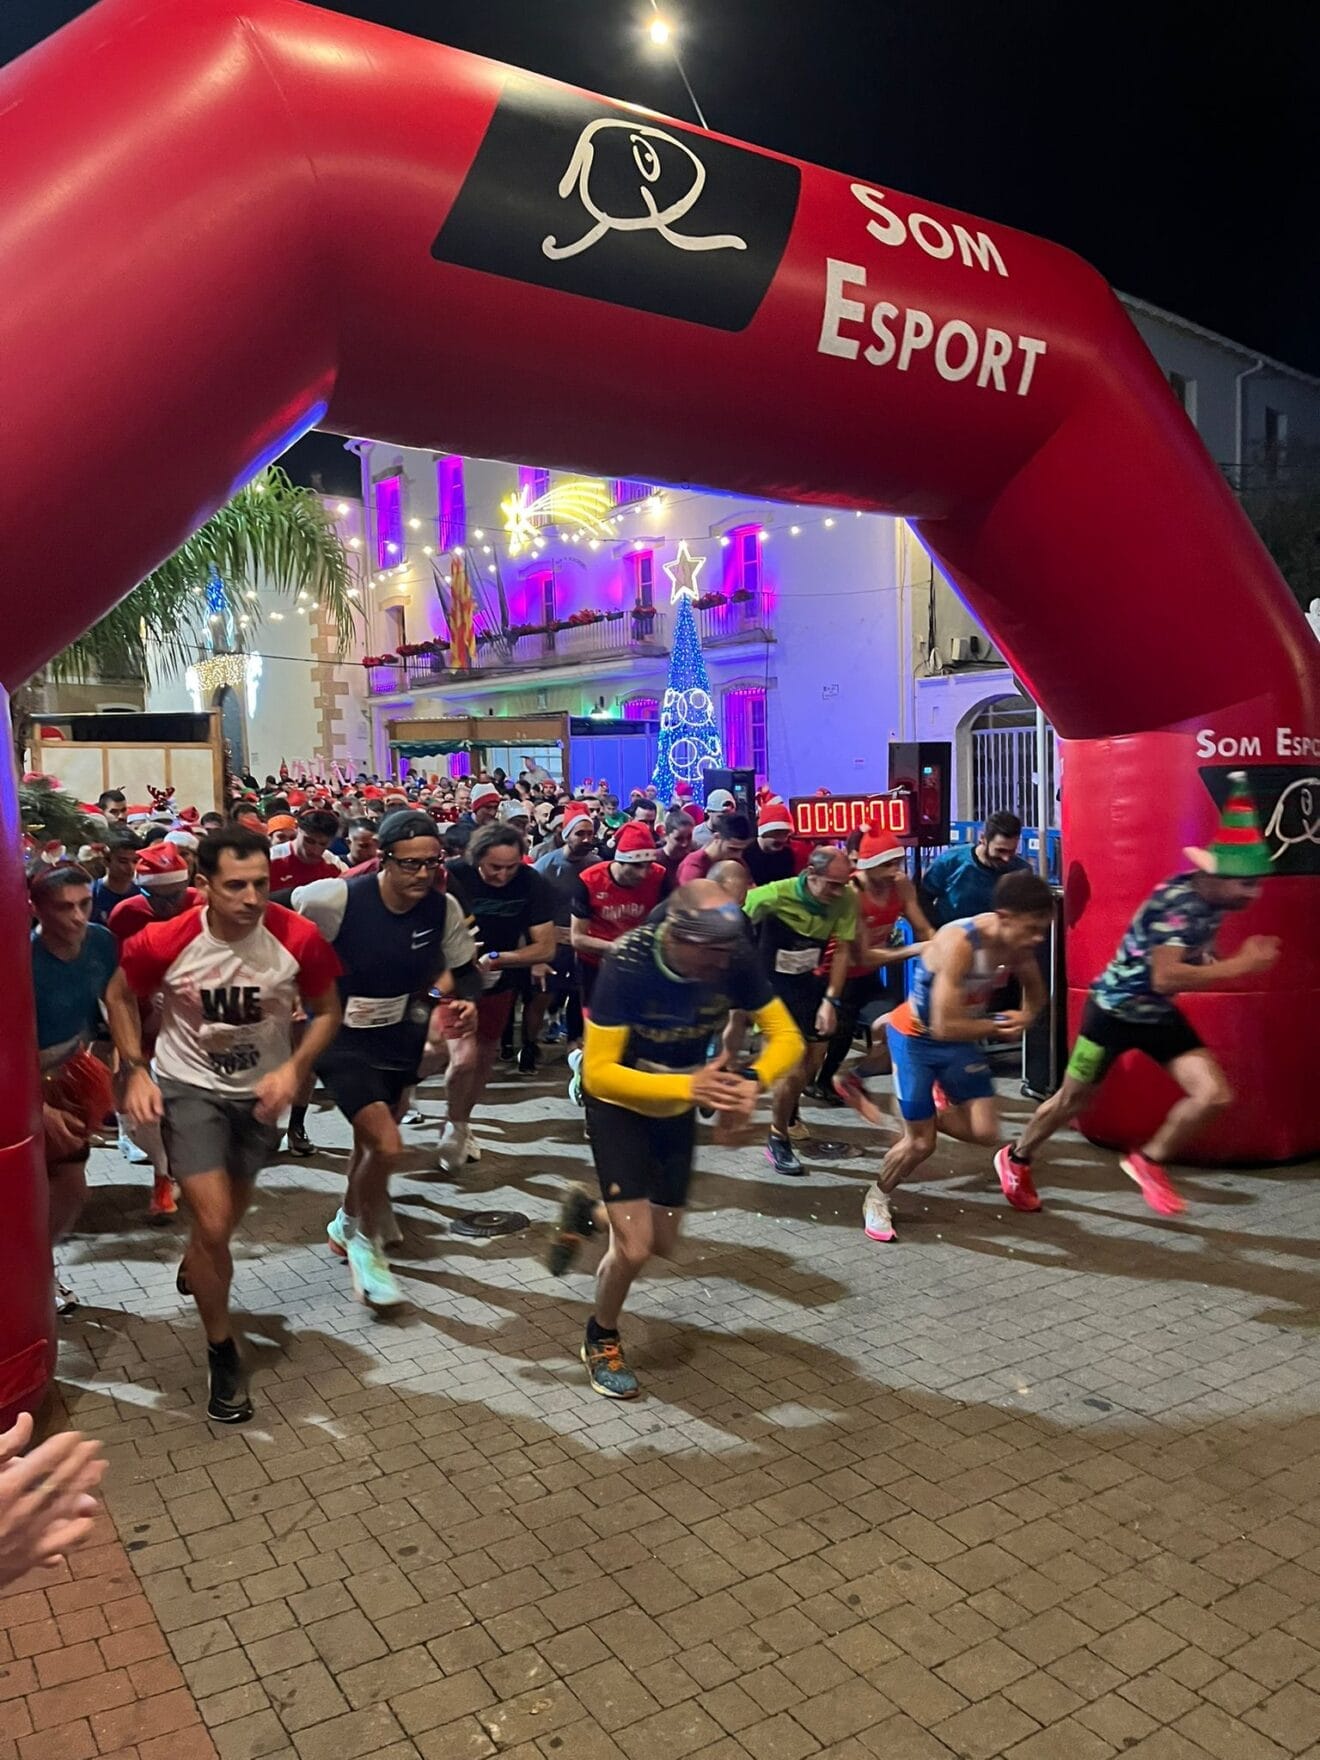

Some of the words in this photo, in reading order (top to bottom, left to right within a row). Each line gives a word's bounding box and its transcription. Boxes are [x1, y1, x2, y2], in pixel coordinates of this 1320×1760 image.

[850, 182, 1009, 277] SOM
[817, 257, 1047, 397] ESPORT
[1196, 729, 1262, 758] SOM
[199, 986, 265, 1026] WE
